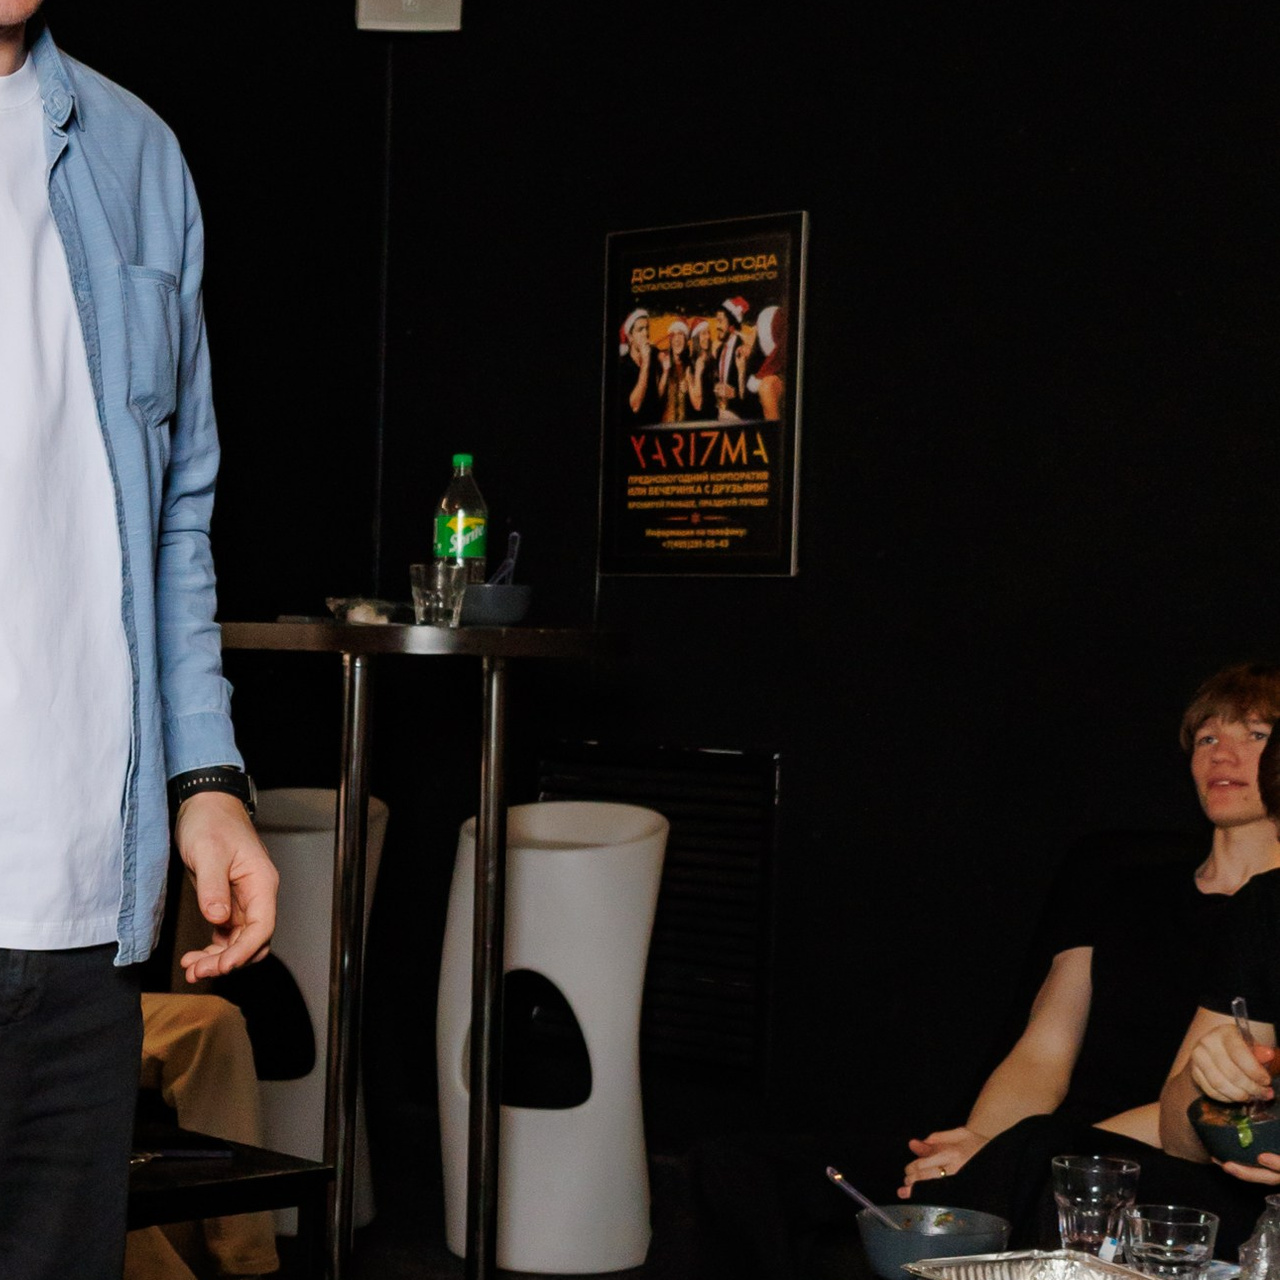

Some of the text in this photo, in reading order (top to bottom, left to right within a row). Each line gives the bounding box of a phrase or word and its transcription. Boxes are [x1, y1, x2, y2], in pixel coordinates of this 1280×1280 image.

[631, 253, 778, 285] ДО НОВОГО ГОДА
